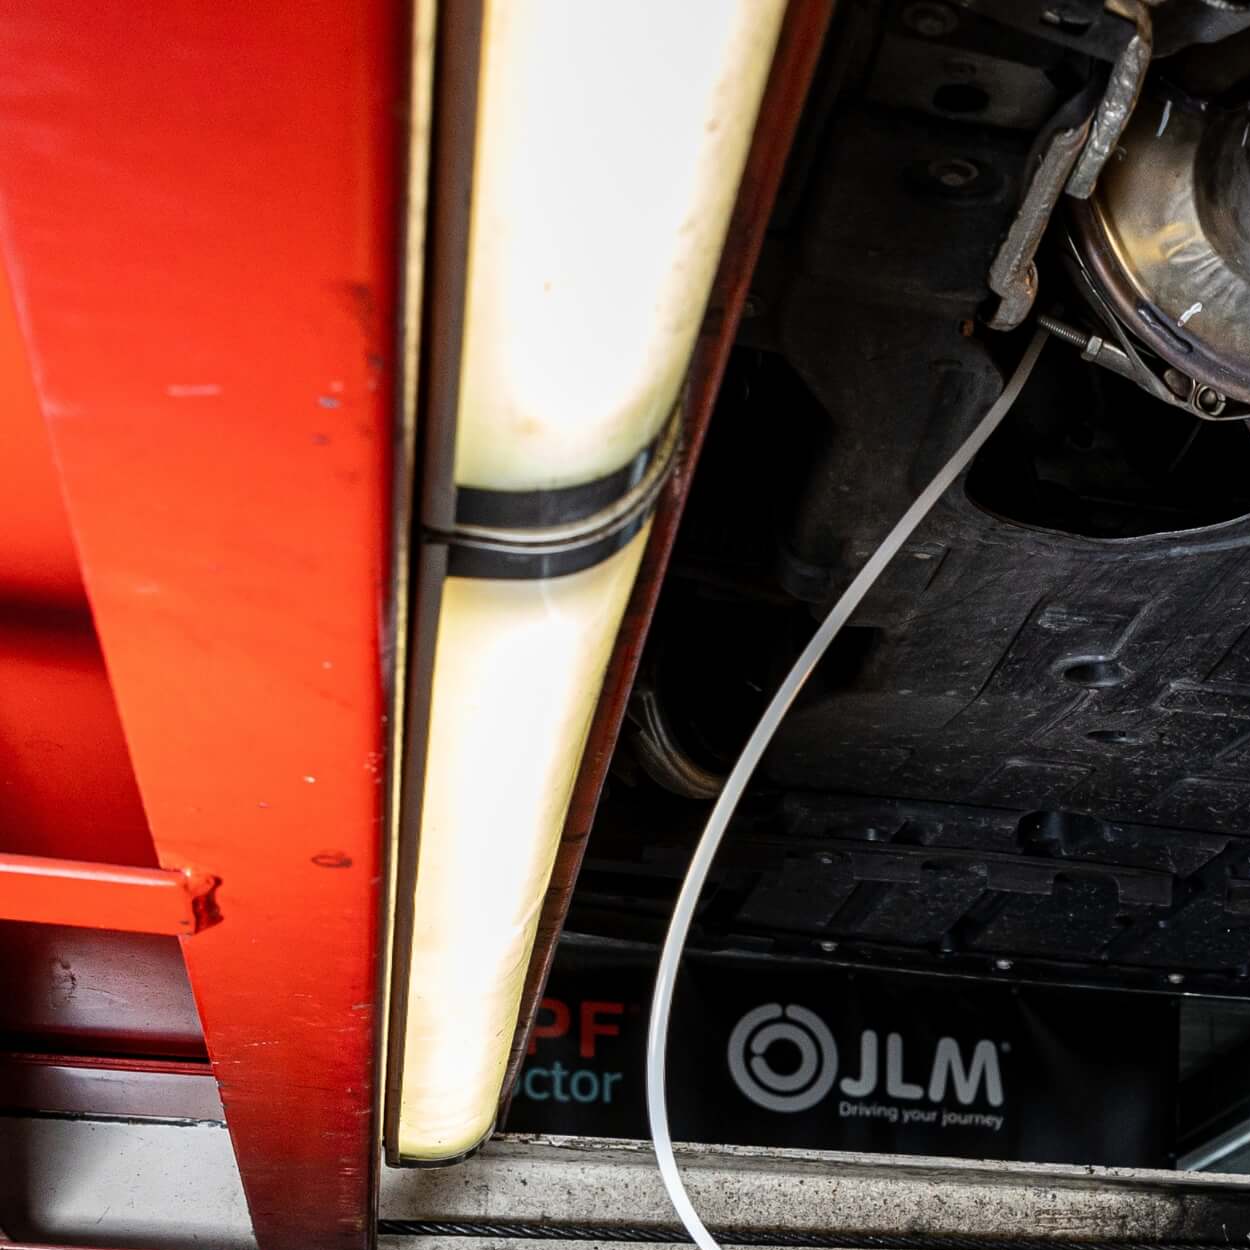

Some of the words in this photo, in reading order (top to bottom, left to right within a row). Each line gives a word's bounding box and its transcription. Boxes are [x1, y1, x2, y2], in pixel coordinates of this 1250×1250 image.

[526, 998, 624, 1059] PF
[513, 1061, 623, 1103] ctor
[840, 1030, 1004, 1107] JLM
[839, 1102, 898, 1121] Driving
[902, 1109, 938, 1123] your
[942, 1109, 1004, 1130] journey
